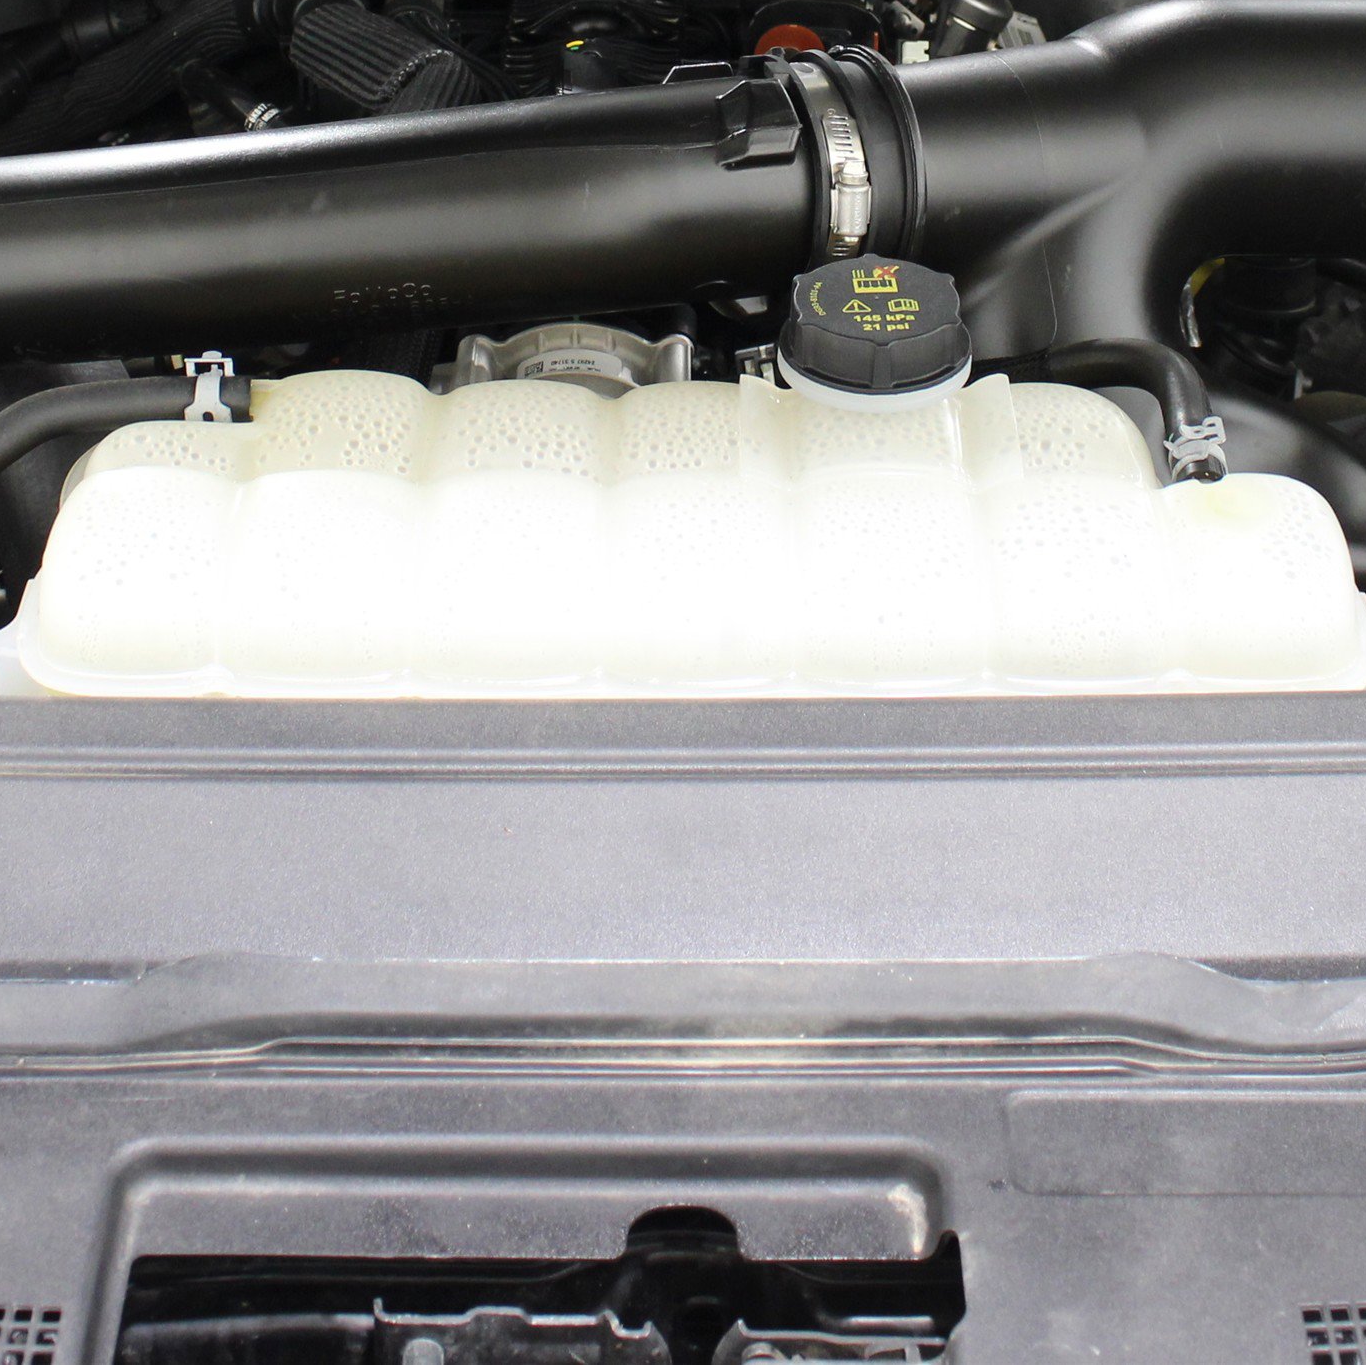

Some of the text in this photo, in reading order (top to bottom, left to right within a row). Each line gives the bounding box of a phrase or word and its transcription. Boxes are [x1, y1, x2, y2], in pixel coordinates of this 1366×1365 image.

[853, 313, 915, 322] 145 kPa
[863, 322, 910, 332] 21 psi
